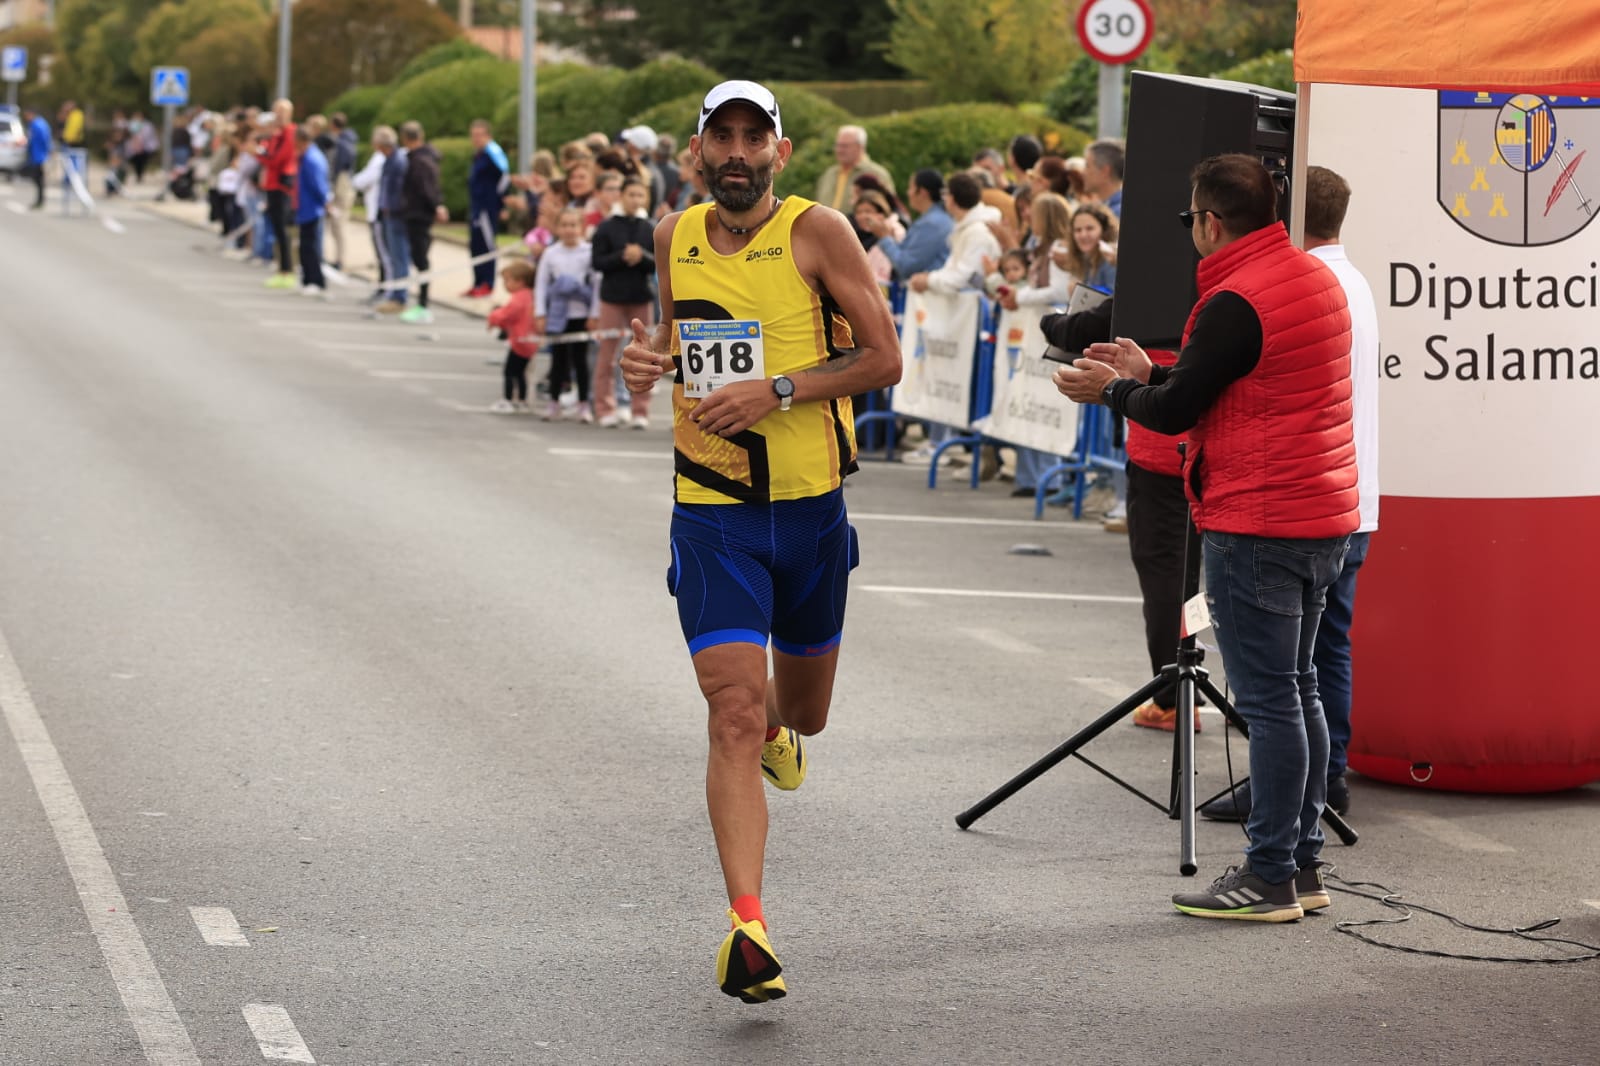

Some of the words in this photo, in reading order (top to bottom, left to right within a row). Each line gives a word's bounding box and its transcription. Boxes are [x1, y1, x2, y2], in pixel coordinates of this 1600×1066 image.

[1095, 12, 1135, 37] 30
[767, 247, 783, 256] GO
[1389, 261, 1597, 320] Diputaci
[687, 342, 754, 374] 618
[1378, 342, 1402, 379] e
